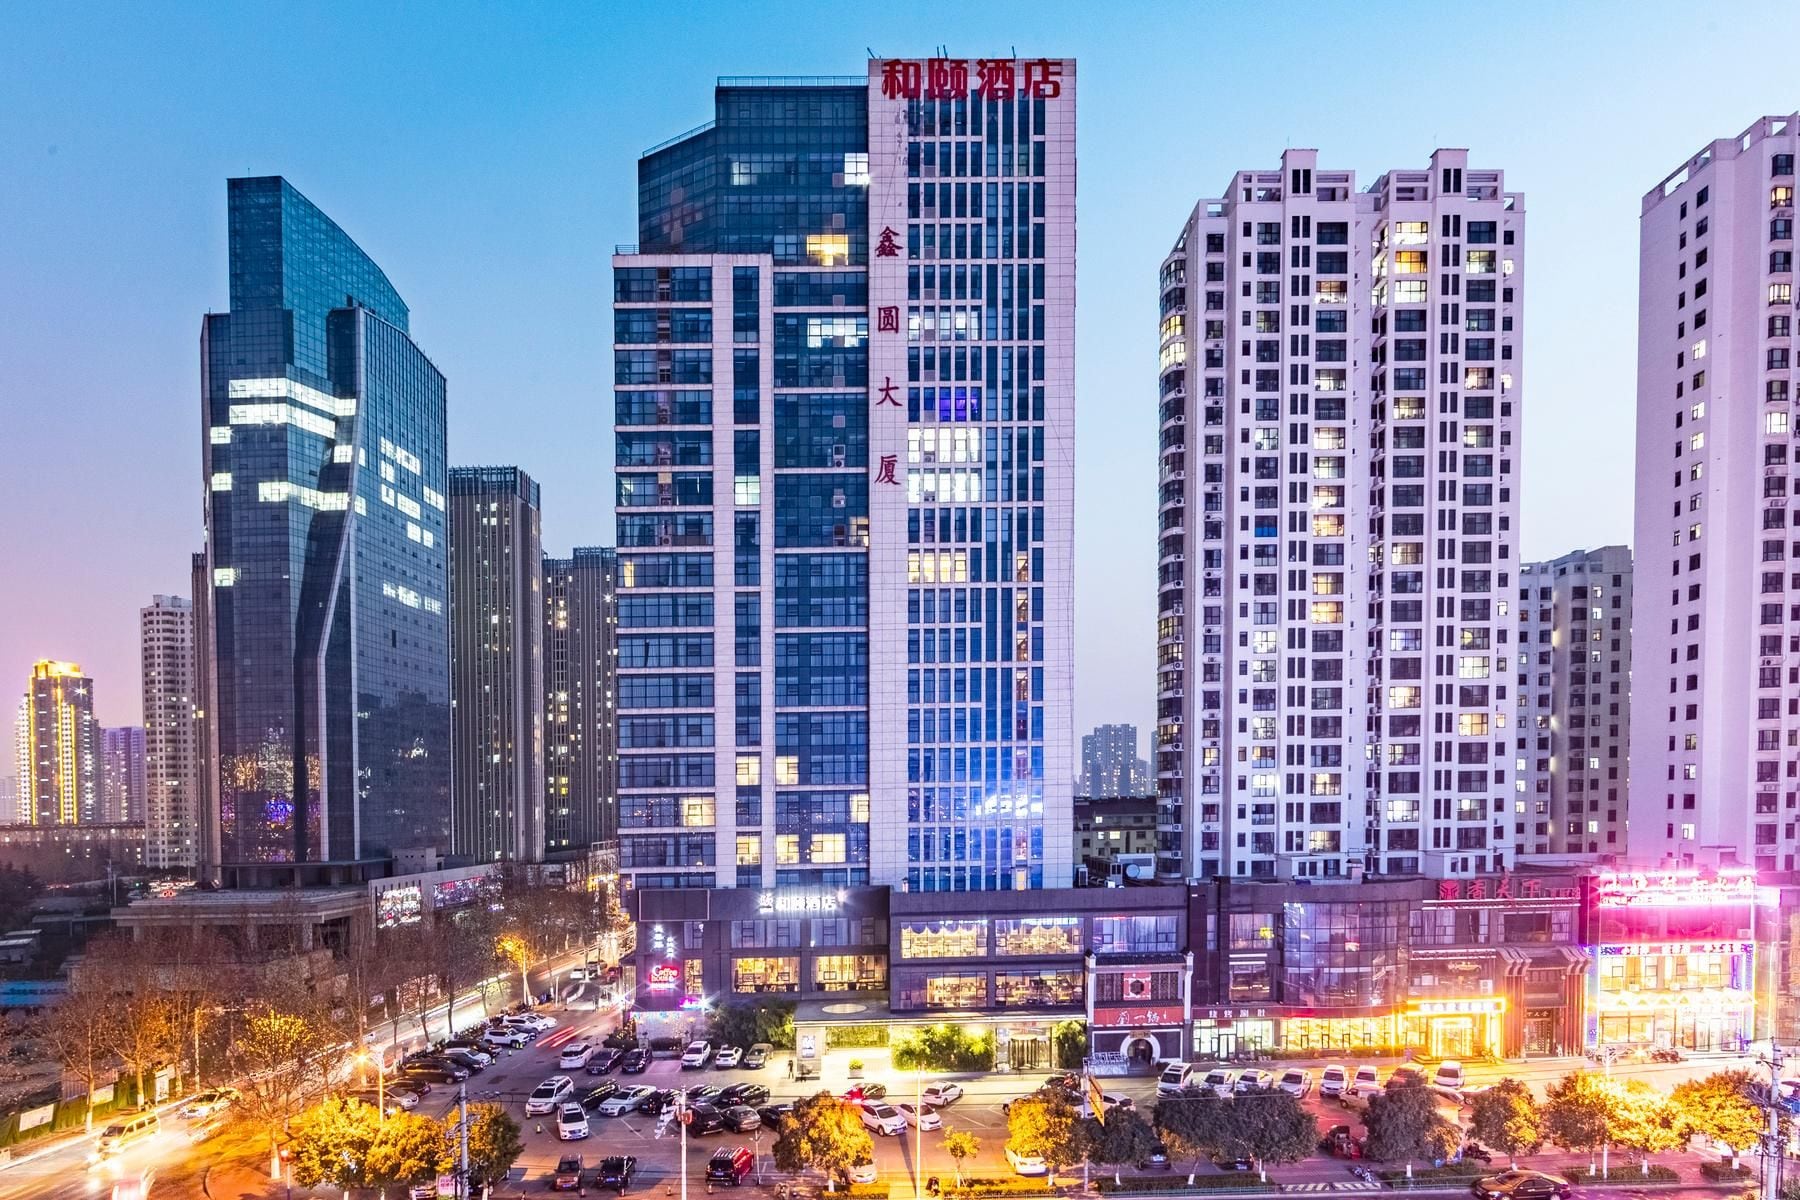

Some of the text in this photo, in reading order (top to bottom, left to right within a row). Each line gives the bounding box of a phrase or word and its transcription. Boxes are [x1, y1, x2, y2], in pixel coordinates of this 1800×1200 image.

[881, 58, 1062, 100] 和颐酒店
[775, 896, 836, 911] 和颐酒店
